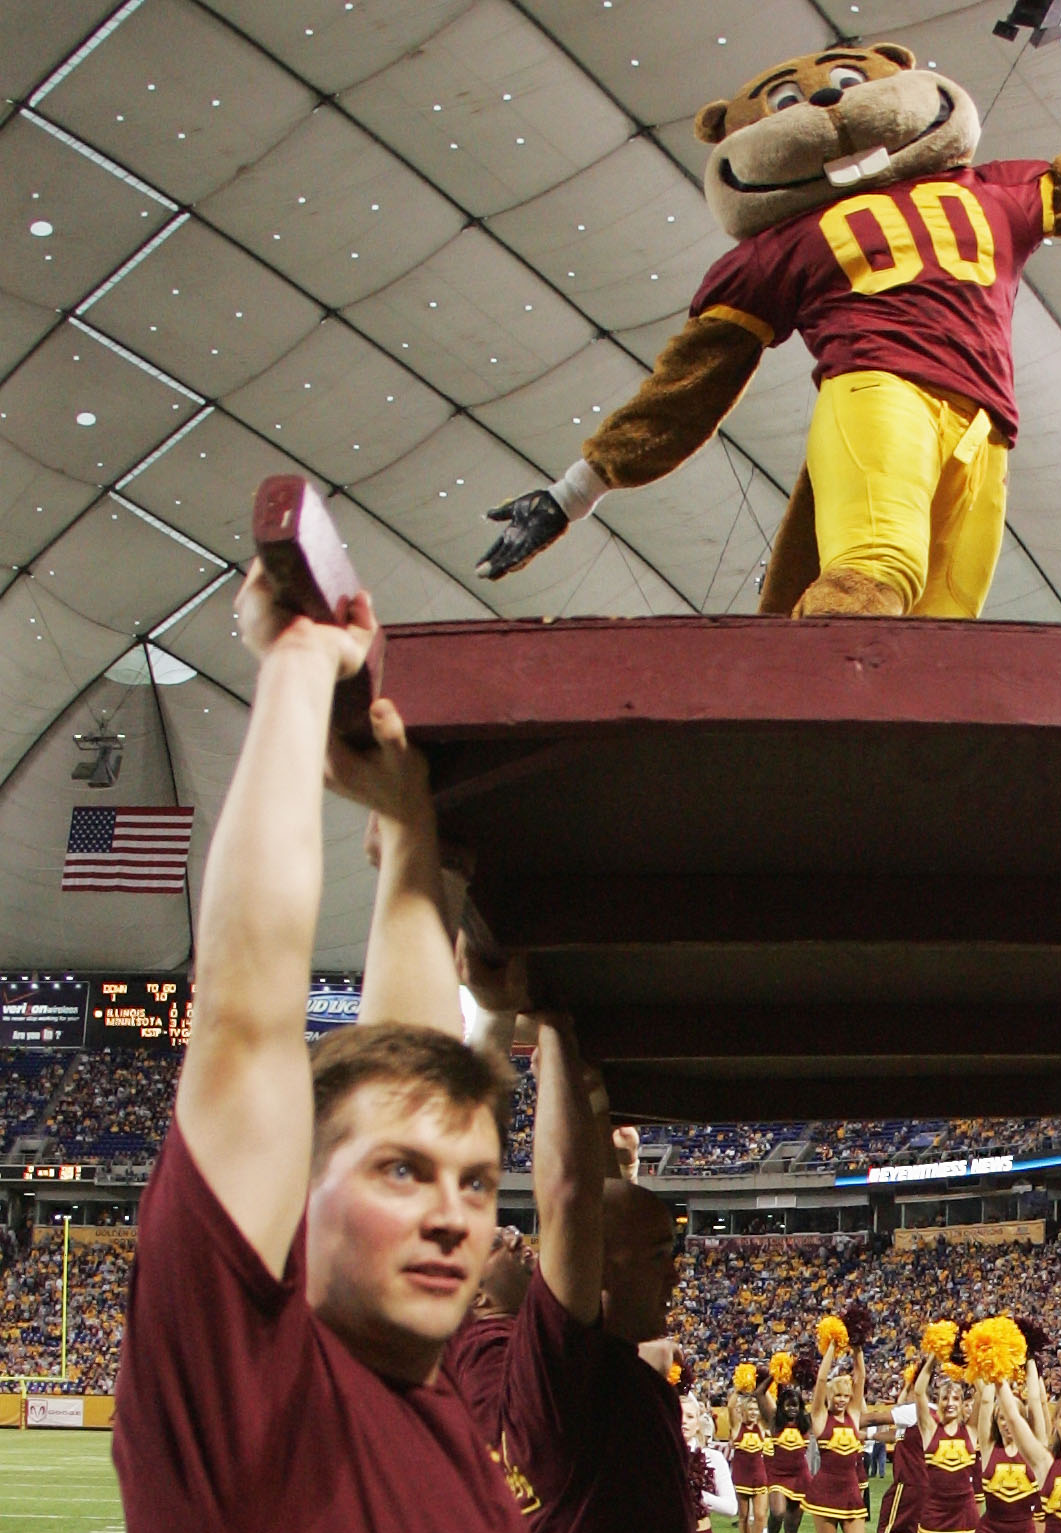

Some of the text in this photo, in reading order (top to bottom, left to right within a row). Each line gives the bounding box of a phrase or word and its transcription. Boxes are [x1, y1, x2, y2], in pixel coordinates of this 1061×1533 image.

[819, 182, 997, 295] 00
[146, 983, 160, 993] TO
[162, 983, 177, 993] GO
[154, 992, 168, 1002] 10
[2, 1002, 48, 1016] verizon
[106, 1008, 146, 1018] ILLINOIS
[105, 1017, 162, 1027] MINNESOTA
[880, 1160, 968, 1182] EYEWITNESS
[970, 1155, 1014, 1174] NEWS
